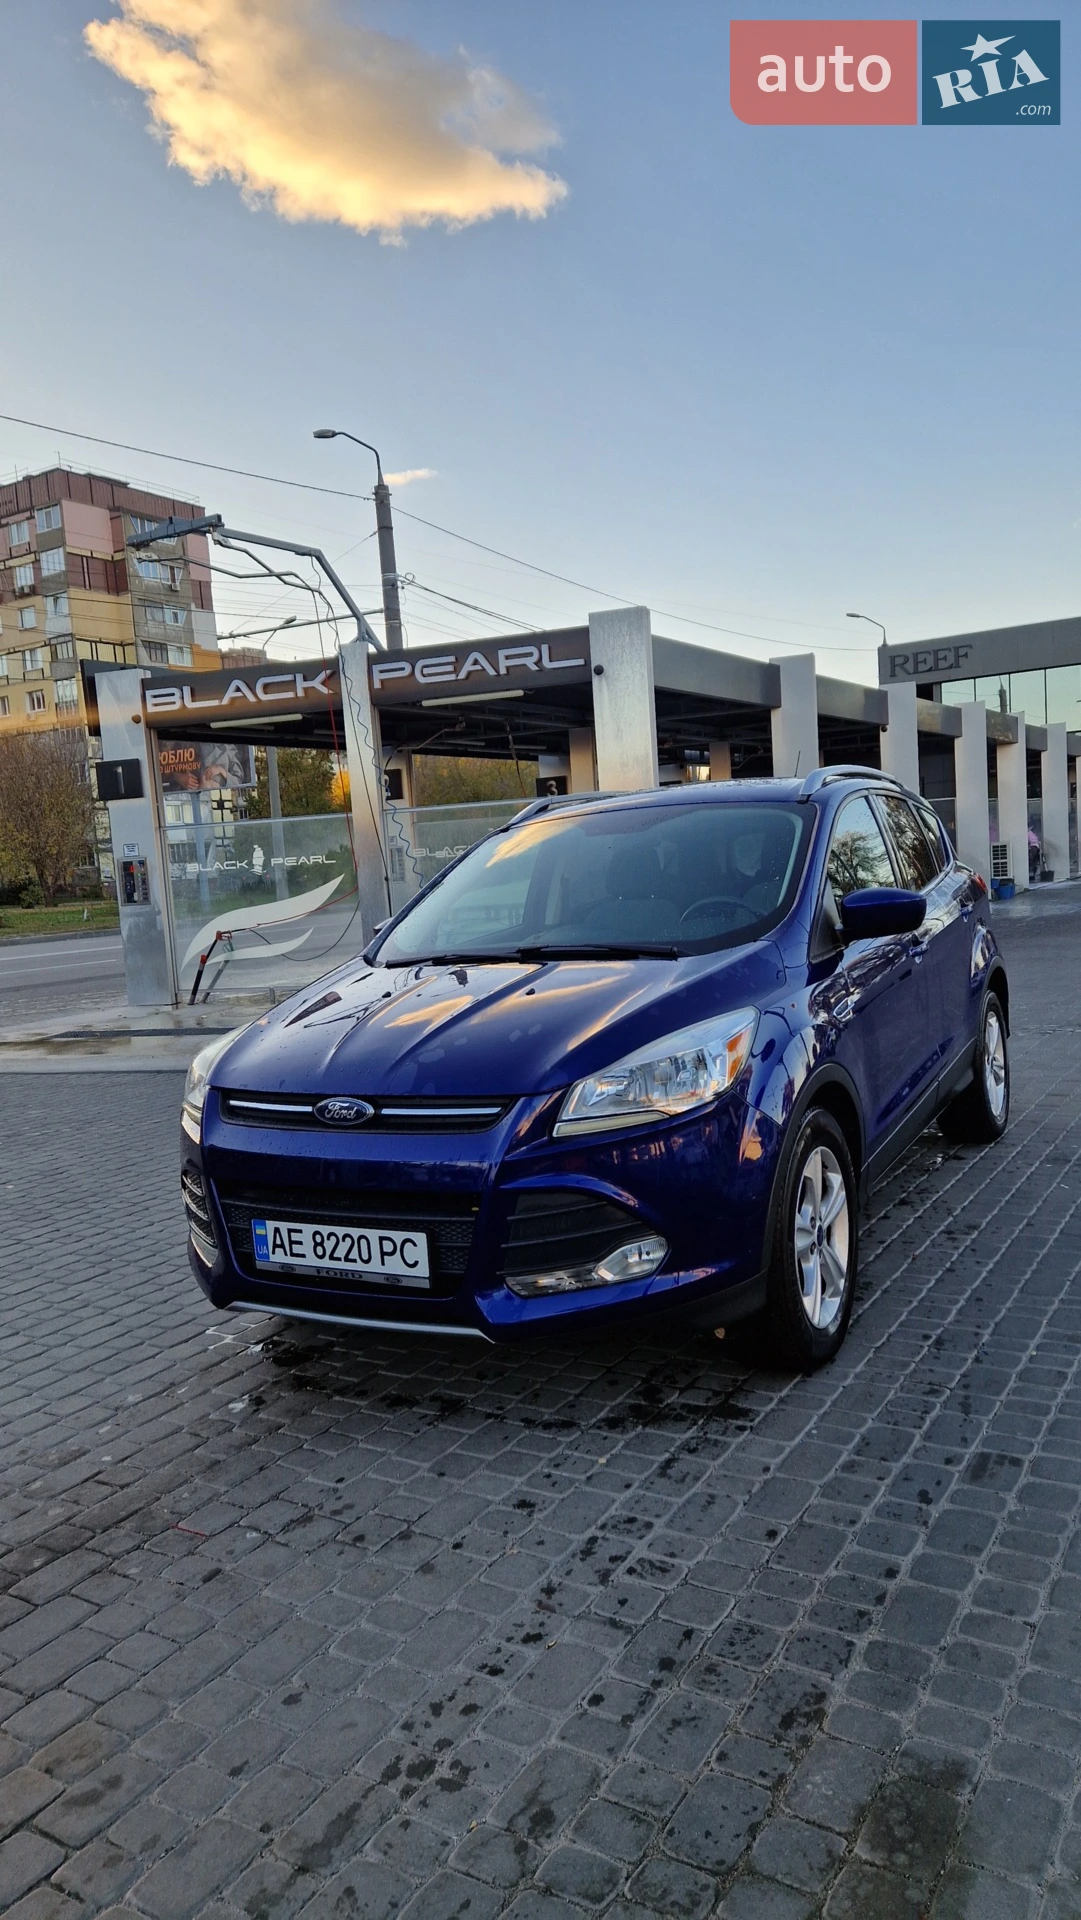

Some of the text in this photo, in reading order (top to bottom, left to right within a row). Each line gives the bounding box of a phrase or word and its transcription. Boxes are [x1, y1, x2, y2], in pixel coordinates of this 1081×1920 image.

[888, 643, 974, 678] REEF
[145, 643, 586, 713] BLACK PEARL
[413, 845, 472, 858] BLAC
[187, 855, 337, 873] BLACK PEARL
[324, 1101, 358, 1119] Ford
[257, 1245, 269, 1255] UA
[271, 1226, 420, 1269] AE 8220 PC
[315, 1268, 364, 1280] FORD
